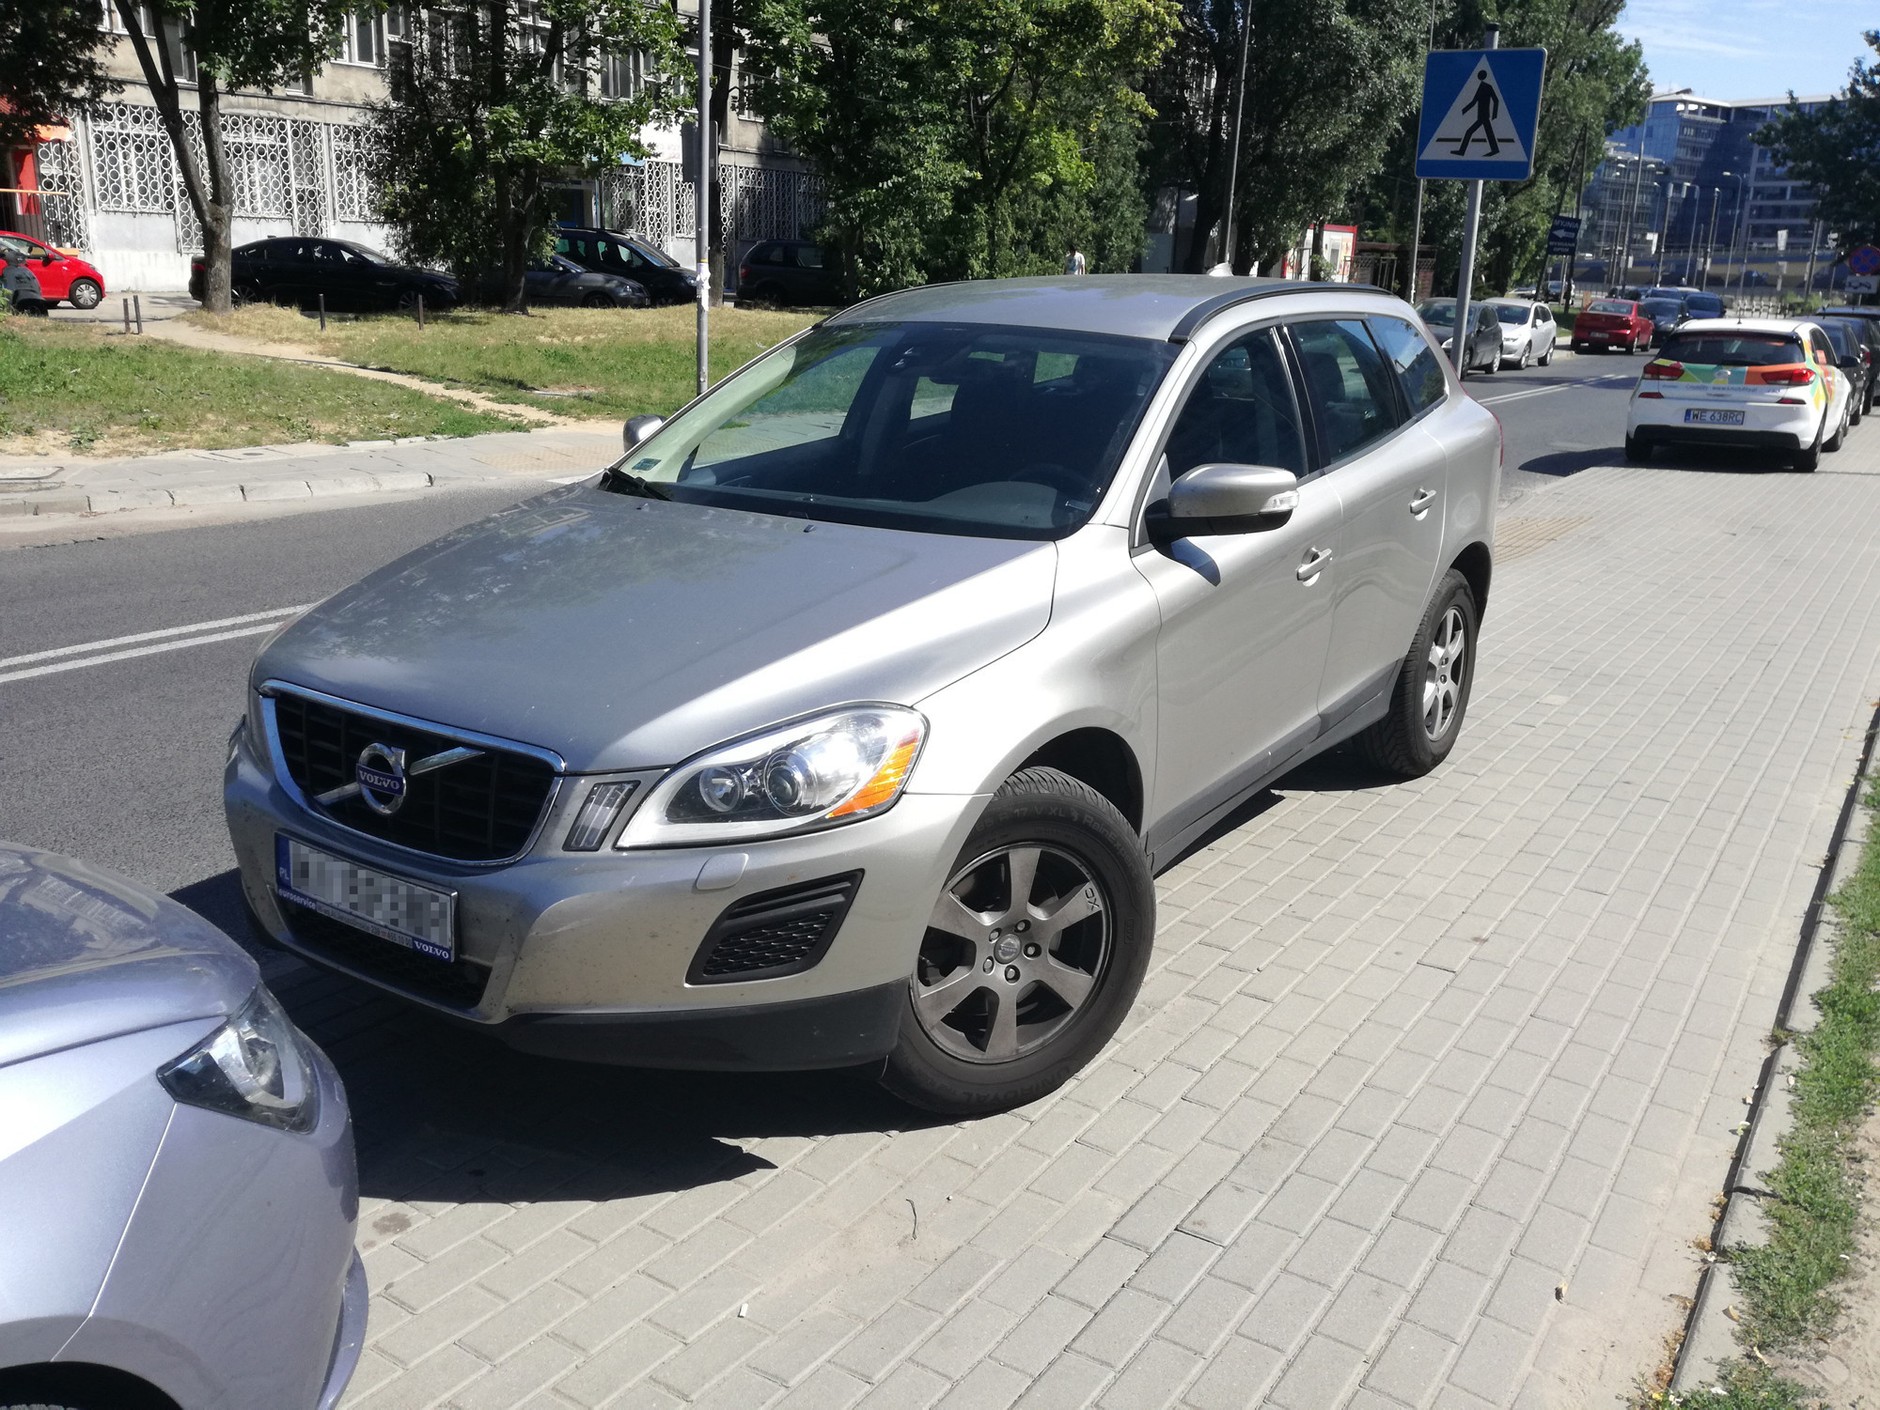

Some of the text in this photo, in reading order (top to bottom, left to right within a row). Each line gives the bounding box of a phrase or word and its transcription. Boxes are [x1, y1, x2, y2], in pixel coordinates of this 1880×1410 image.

[1692, 411, 1743, 424] WE 638RC
[359, 770, 400, 790] VOLVO
[1014, 807, 1028, 818] 17
[1049, 806, 1066, 817] XL
[279, 866, 290, 881] PL
[413, 940, 450, 959] VOLVO
